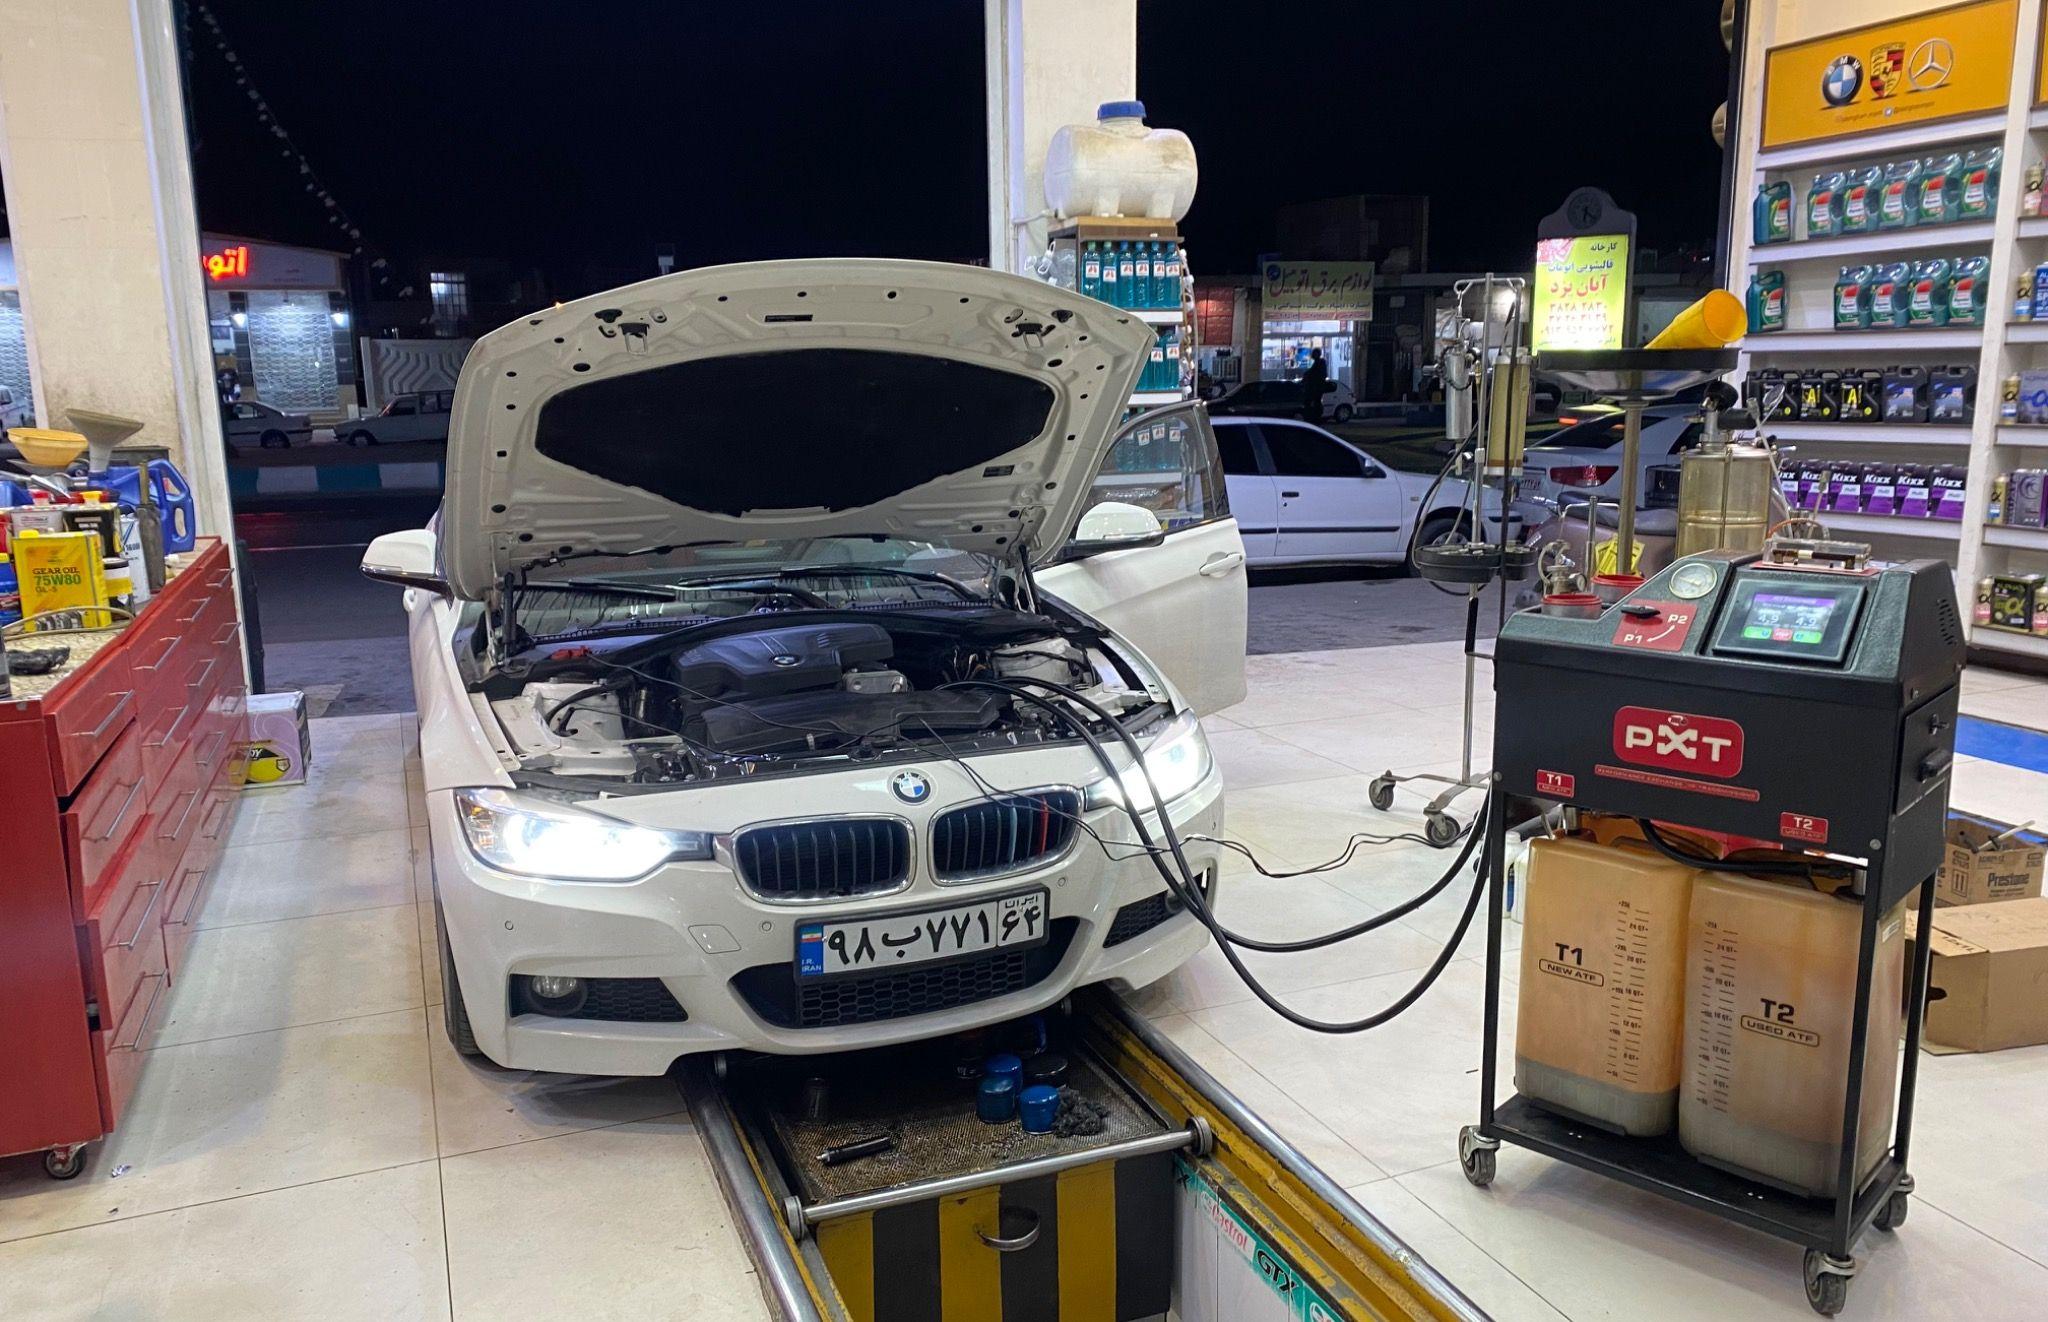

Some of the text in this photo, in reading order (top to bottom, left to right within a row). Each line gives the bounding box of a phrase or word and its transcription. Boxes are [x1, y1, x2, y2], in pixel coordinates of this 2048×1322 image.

[1831, 473, 1857, 483] Kixx
[1864, 474, 1891, 484] Kixx
[1895, 476, 1925, 486] Kixx
[1932, 477, 1963, 488] Kixx
[32, 567, 80, 575] GEAR OIL
[34, 575, 82, 586] 75W80
[1667, 614, 1688, 624] P2
[1623, 634, 1643, 644] P1
[1625, 724, 1732, 762] PXT
[1546, 773, 1562, 786] T1
[1792, 816, 1813, 830] T2
[1987, 872, 2030, 887] Prestone
[1005, 894, 1038, 908] ایران
[1002, 905, 1042, 942] ۶۴
[1555, 942, 1584, 966] T1
[802, 963, 822, 972] IRAN
[1547, 963, 1596, 982] NEW ATF
[1760, 997, 1795, 1025] T2
[1746, 1019, 1814, 1043] USED ATF
[1257, 1250, 1299, 1301] GTX
